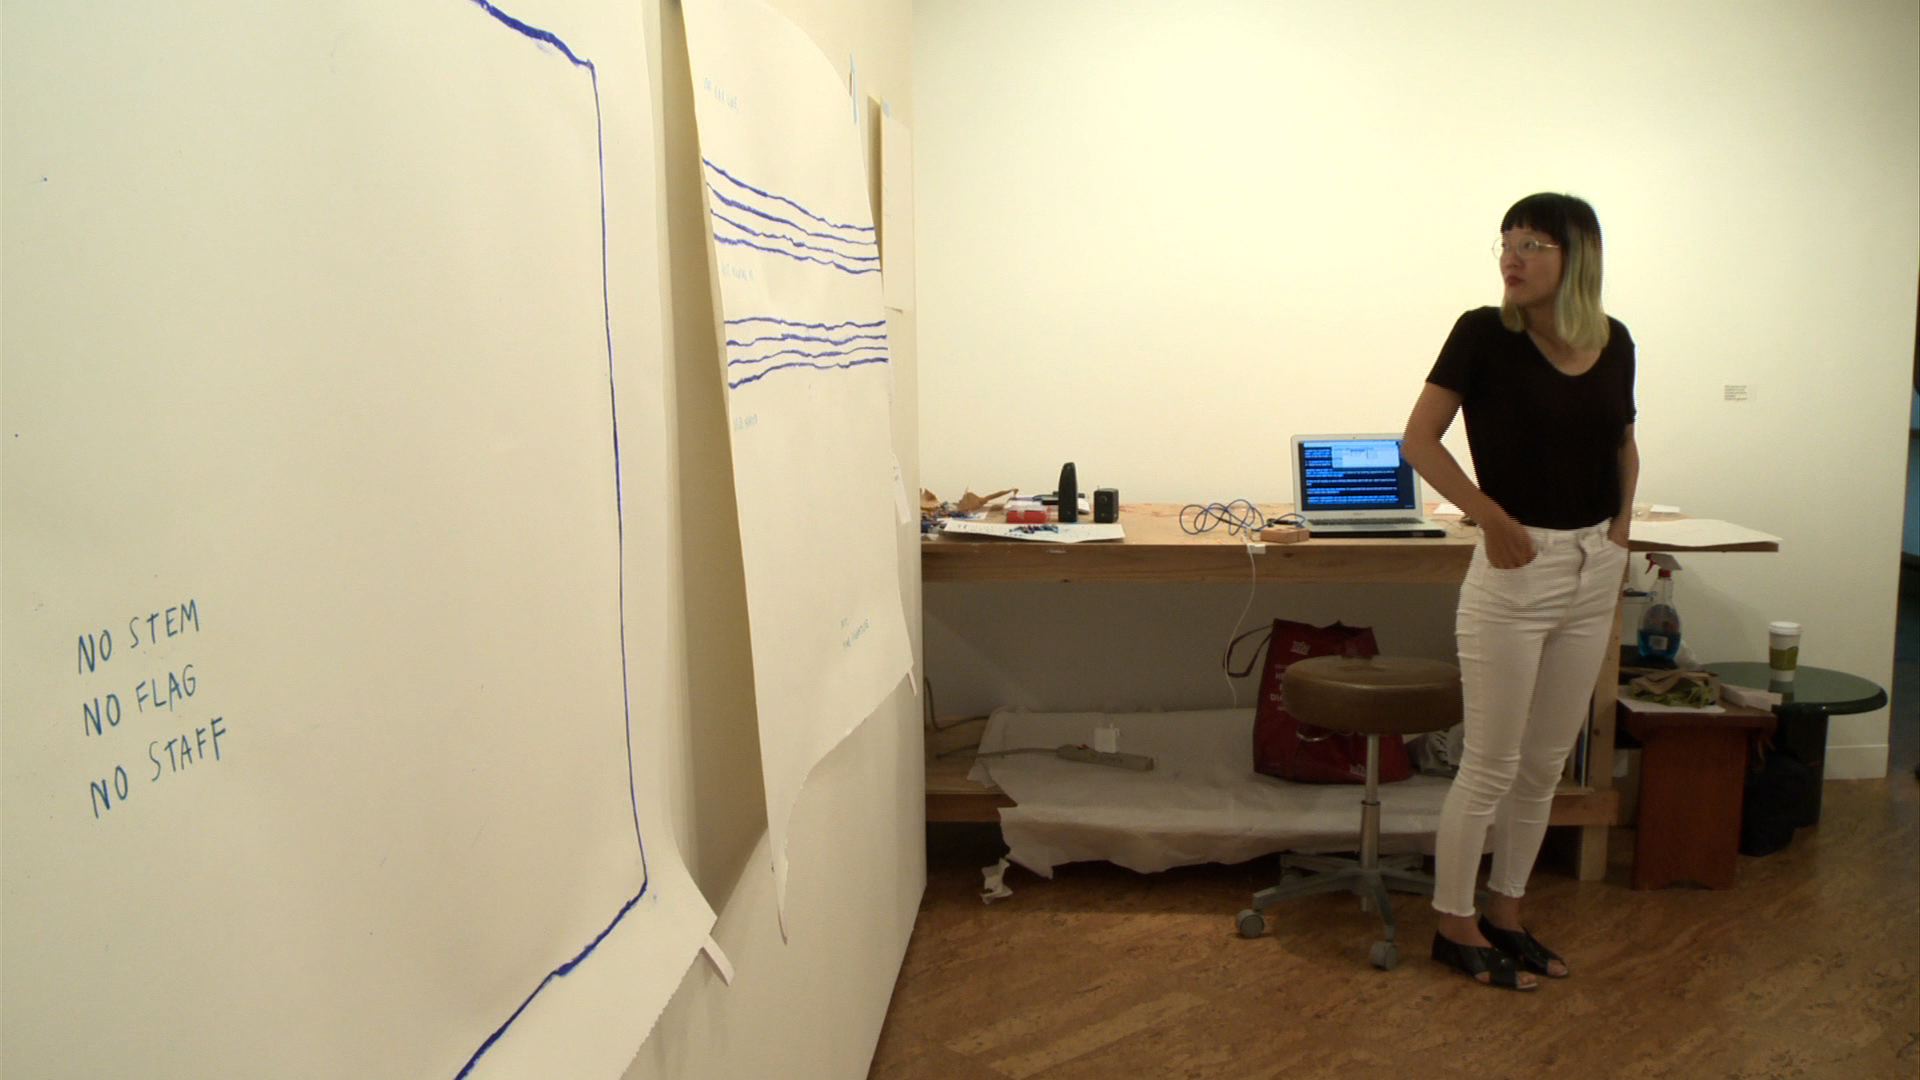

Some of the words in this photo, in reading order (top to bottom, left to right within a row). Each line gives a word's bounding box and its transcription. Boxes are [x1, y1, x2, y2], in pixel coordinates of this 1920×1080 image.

[78, 629, 112, 674] NO
[129, 599, 199, 648] STEM
[83, 693, 121, 736] NO
[135, 664, 196, 712] FLAG
[90, 765, 129, 819] NO
[149, 716, 226, 781] STAFF
